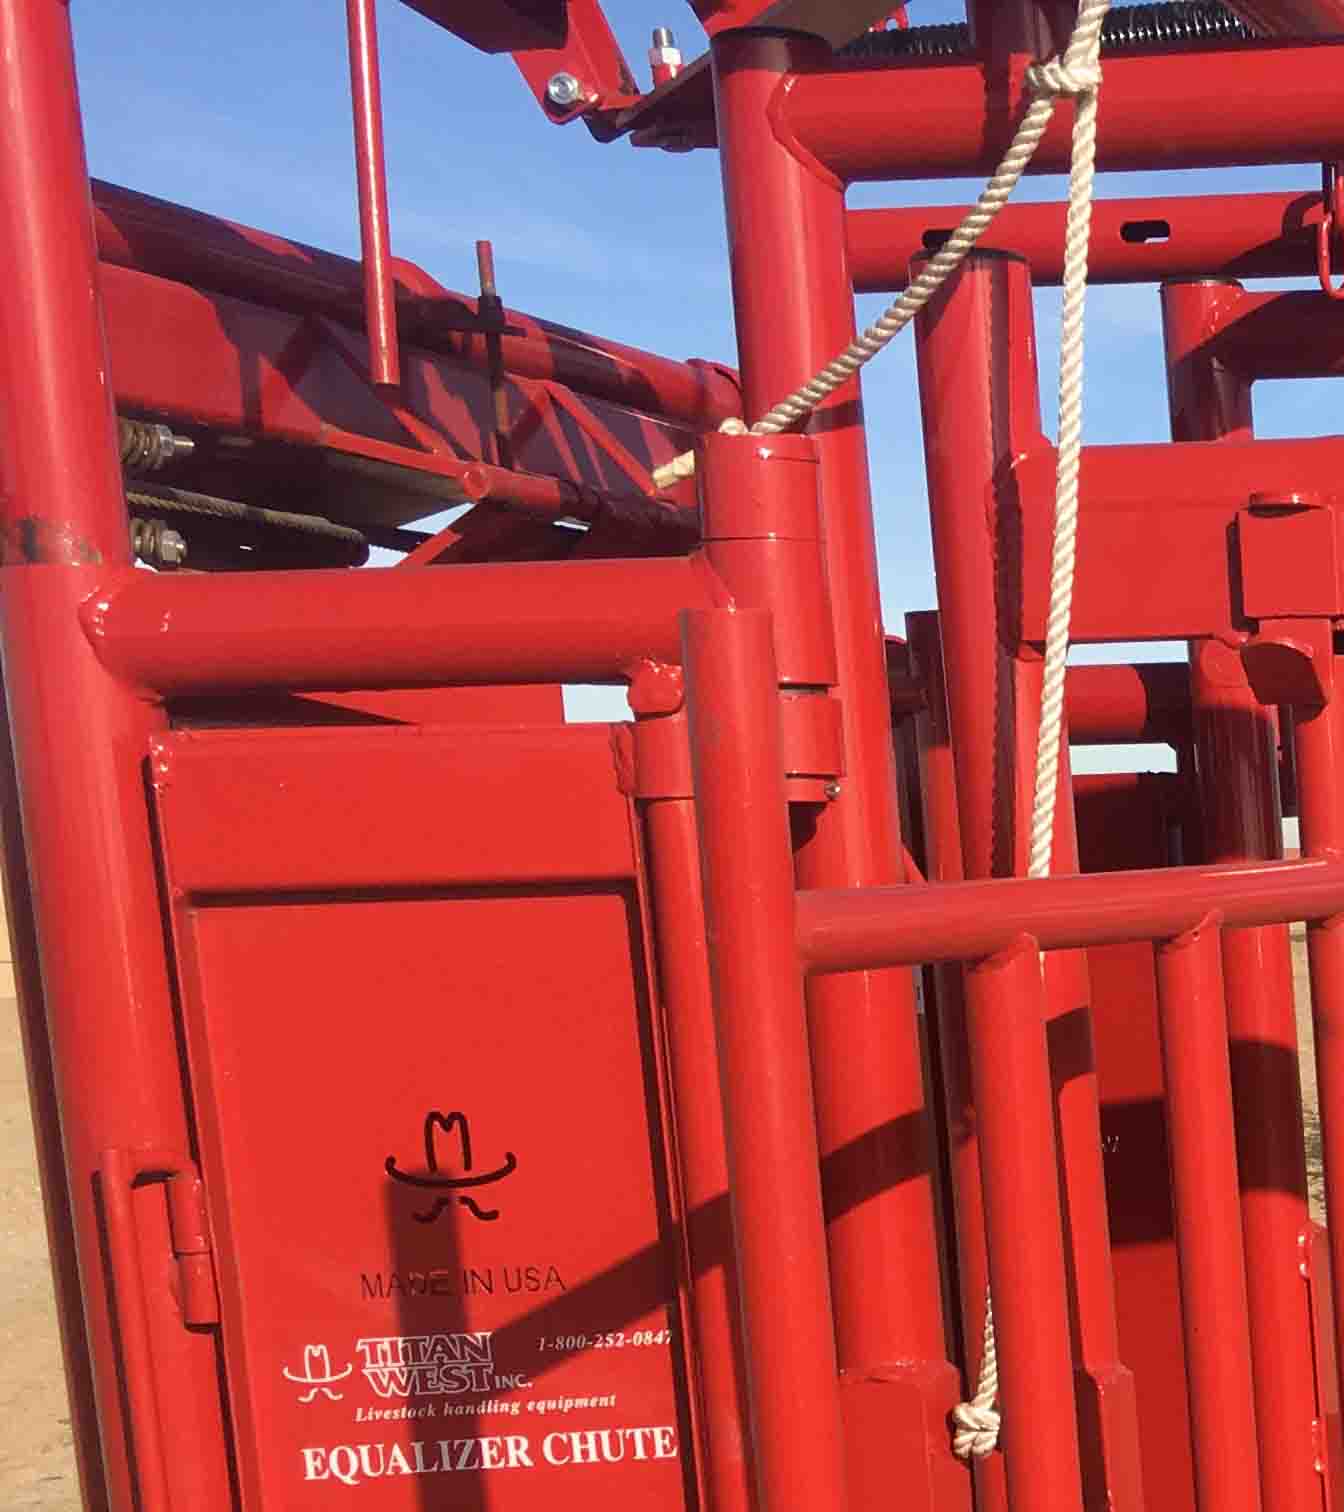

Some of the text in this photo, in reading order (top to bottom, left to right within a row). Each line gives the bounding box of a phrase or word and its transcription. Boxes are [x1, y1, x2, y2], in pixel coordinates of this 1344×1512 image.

[361, 1265, 567, 1300] MADE IN USA
[356, 1332, 493, 1369] TITAN
[363, 1363, 534, 1398] WEST INC.
[354, 1394, 617, 1422] Livestock handling equipment
[302, 1425, 678, 1485] EQUALIZER CHUTE
